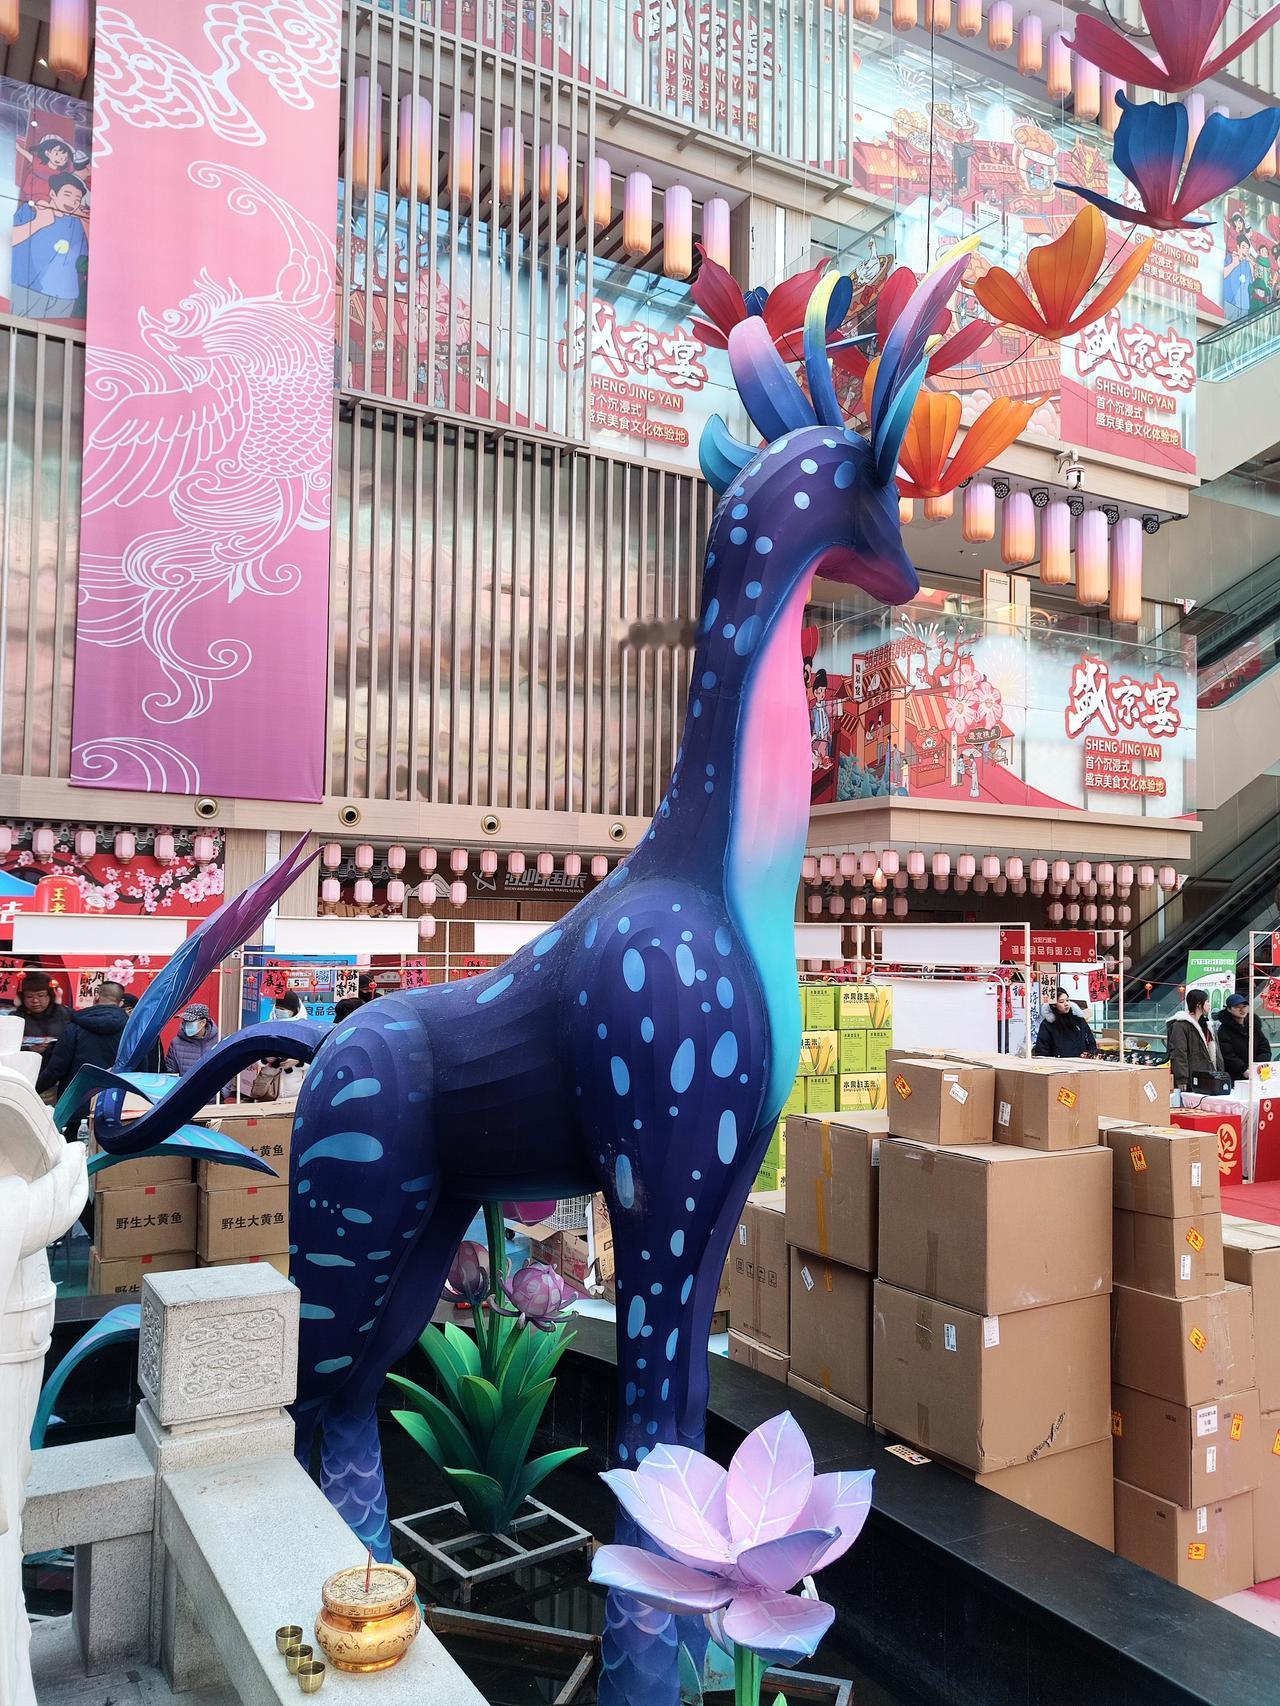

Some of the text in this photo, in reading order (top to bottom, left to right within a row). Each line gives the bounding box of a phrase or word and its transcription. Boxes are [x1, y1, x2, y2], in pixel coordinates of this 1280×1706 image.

[1135, 234, 1197, 265] SHNG JING YAN
[1140, 262, 1201, 292] 京美食文化体验地
[591, 378, 681, 408] HENG JING YAN
[1096, 379, 1175, 411] SHENG JING YAN
[1096, 396, 1143, 420] 首个沉浸式
[1095, 414, 1179, 446] 盛京美食文化体验地
[1067, 657, 1179, 736] 盛京宴
[1085, 738, 1160, 758] SHENG JING YAN
[1085, 756, 1130, 773] 首个沉浸式
[1085, 774, 1165, 793] 盛京美食文化体验地
[116, 1211, 183, 1230] 野生大黄鱼
[221, 1211, 285, 1230] 野生大黄鱼
